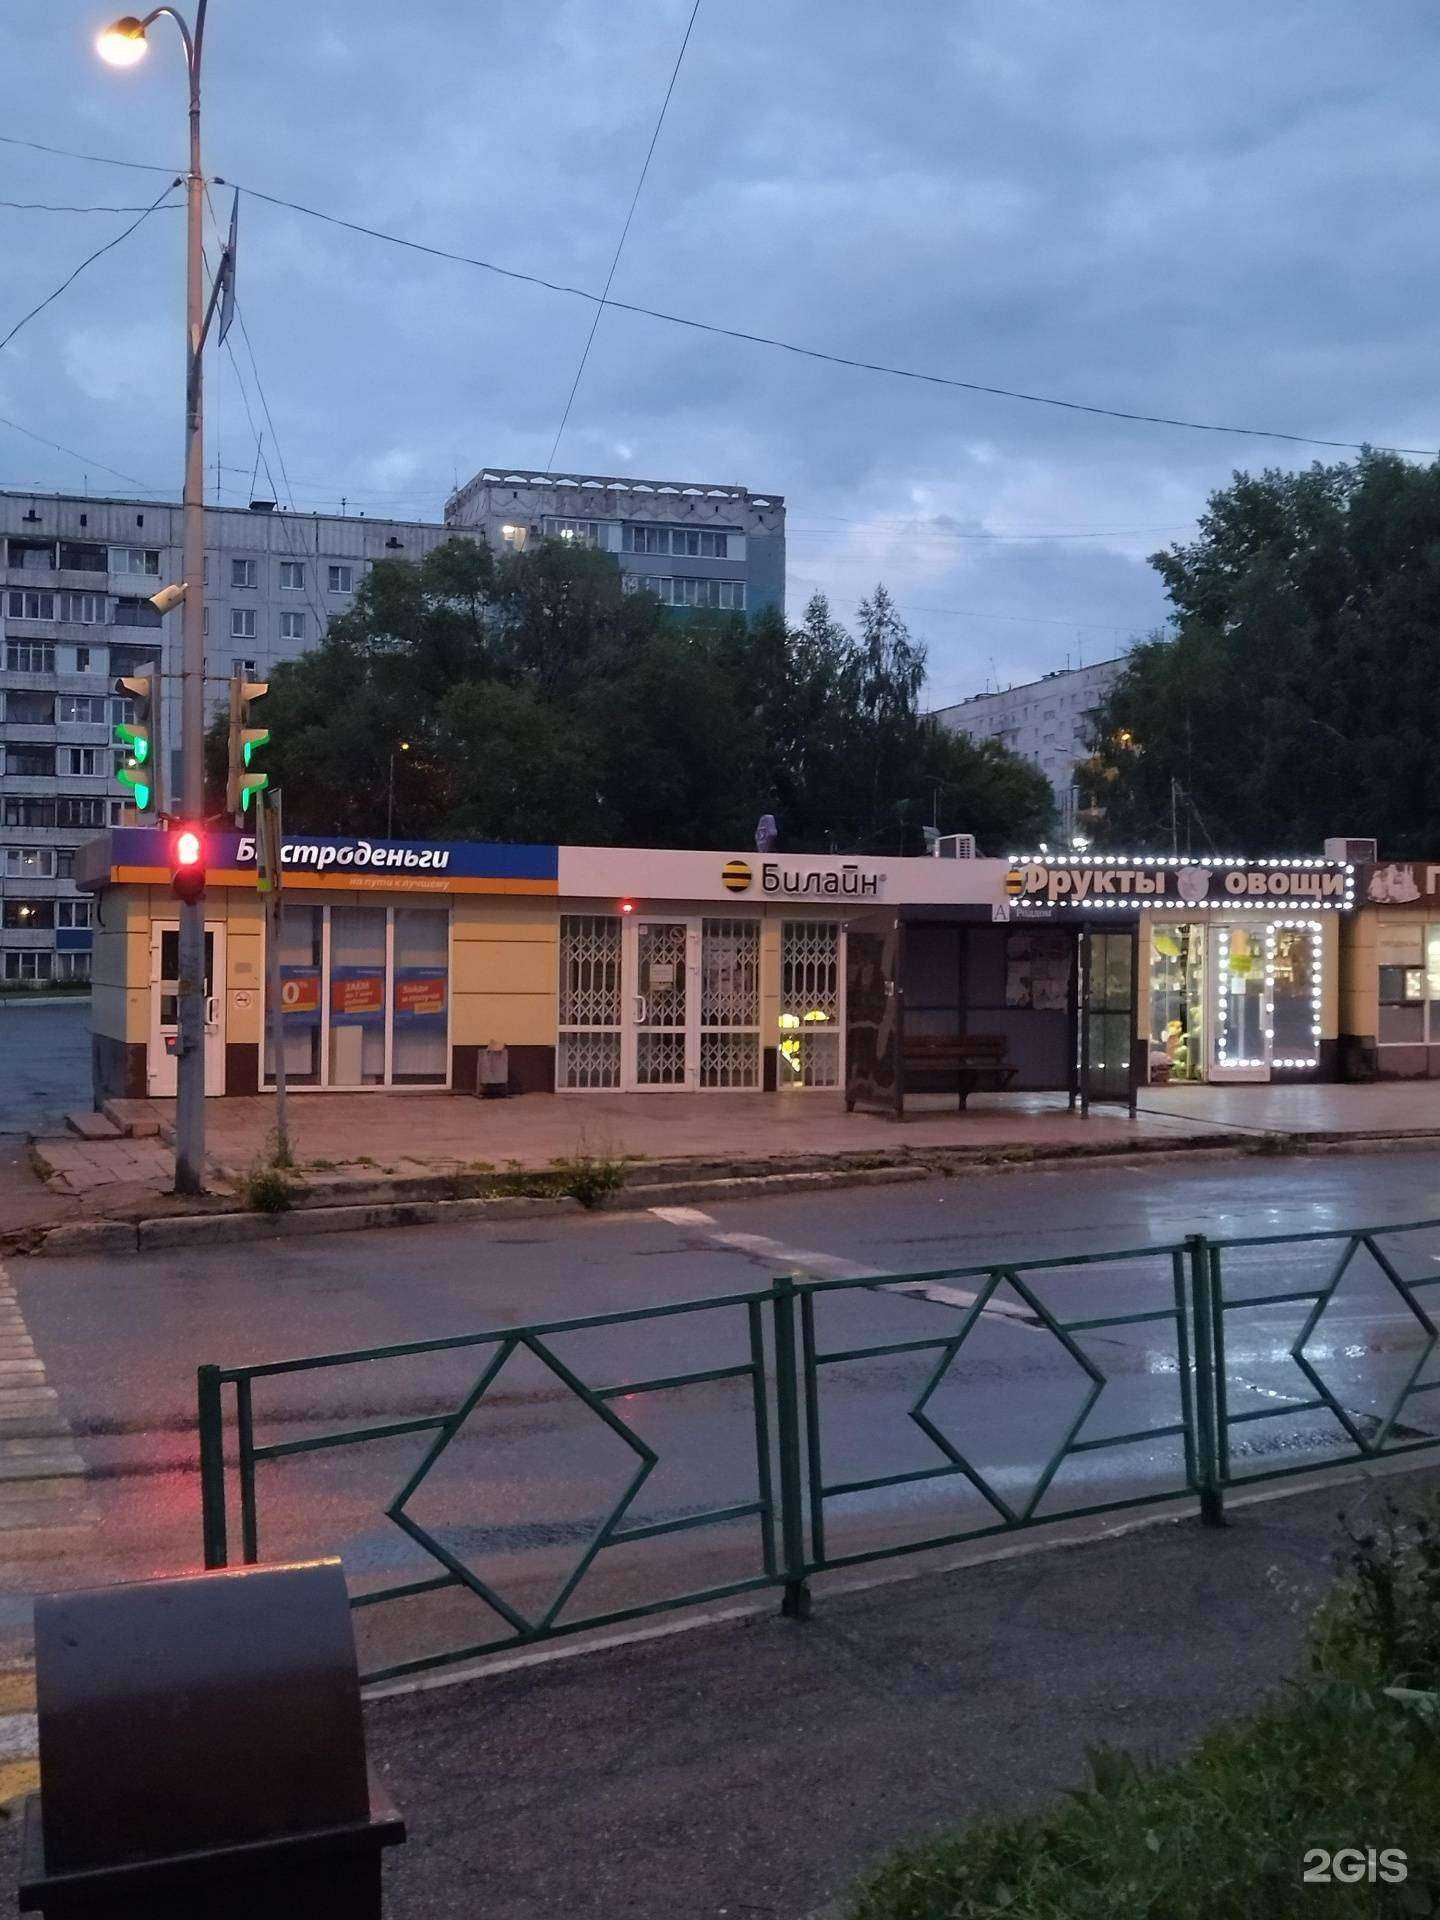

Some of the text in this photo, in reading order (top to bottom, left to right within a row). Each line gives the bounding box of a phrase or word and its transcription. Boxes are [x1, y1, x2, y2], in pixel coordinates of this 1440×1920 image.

[236, 837, 450, 870] Бстроденьги
[762, 863, 878, 895] Билайн
[1023, 863, 1166, 900] Фрукты
